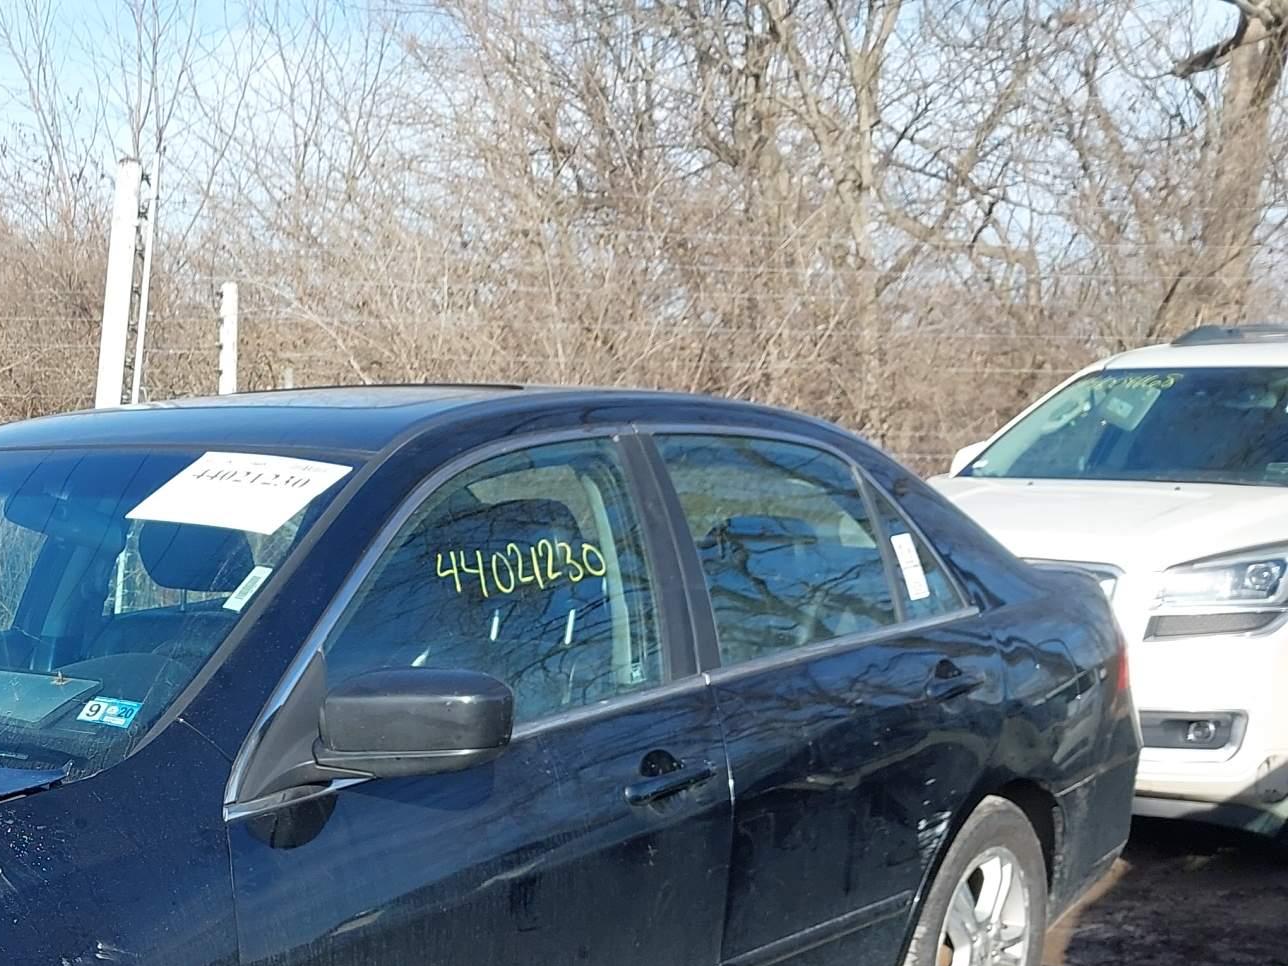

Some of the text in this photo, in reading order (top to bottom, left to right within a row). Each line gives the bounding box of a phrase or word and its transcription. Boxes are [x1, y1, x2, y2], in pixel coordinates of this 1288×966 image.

[437, 540, 606, 597] 44021230
[86, 703, 134, 719] 9 20
